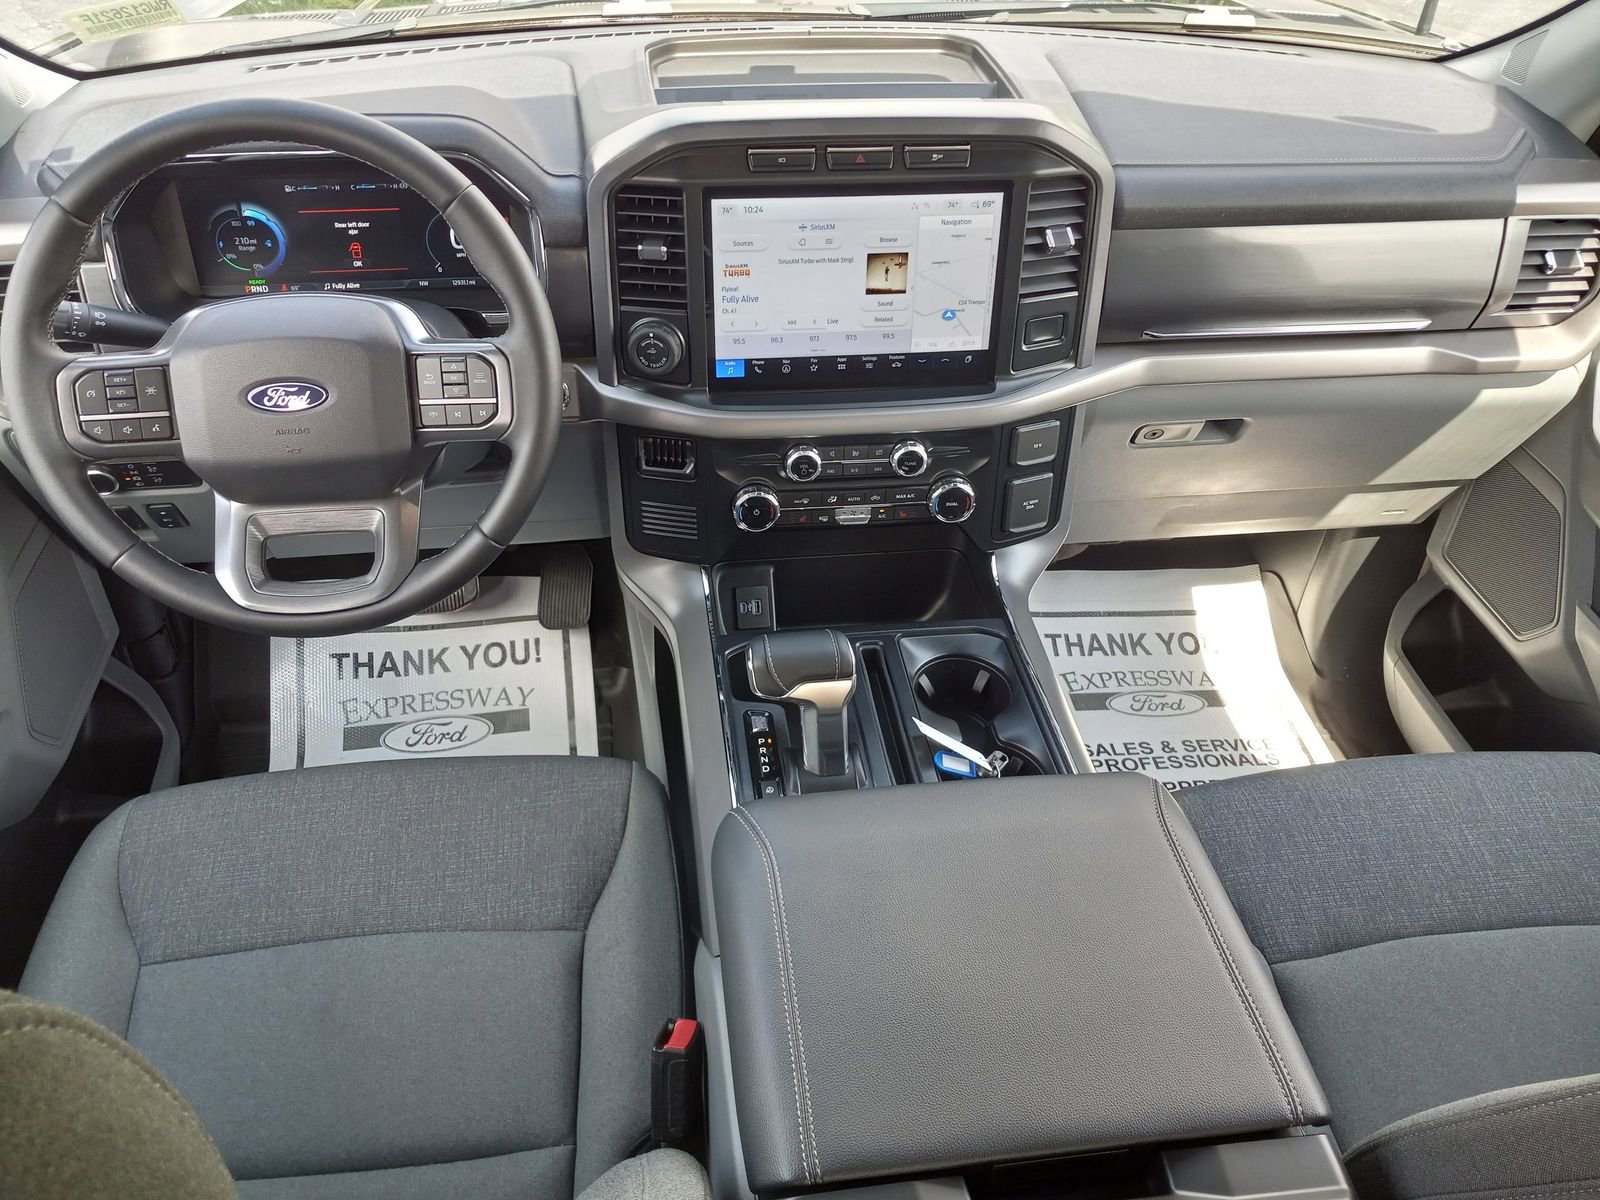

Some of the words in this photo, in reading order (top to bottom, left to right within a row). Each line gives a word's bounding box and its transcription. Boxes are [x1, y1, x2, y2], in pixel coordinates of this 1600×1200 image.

[723, 269, 750, 277] TURBO
[722, 296, 739, 304] Fully
[741, 295, 759, 303] Alive
[264, 386, 311, 406] Ford
[1044, 632, 1152, 658] THANK
[1155, 632, 1207, 656] YO
[330, 646, 451, 680] THANK
[459, 637, 542, 670] YOU!
[1130, 695, 1186, 713] Ford
[405, 721, 468, 748] Ford
[1084, 740, 1156, 758] SALES
[1161, 740, 1178, 754] &
[1092, 753, 1280, 772] PROFESSIONALS
